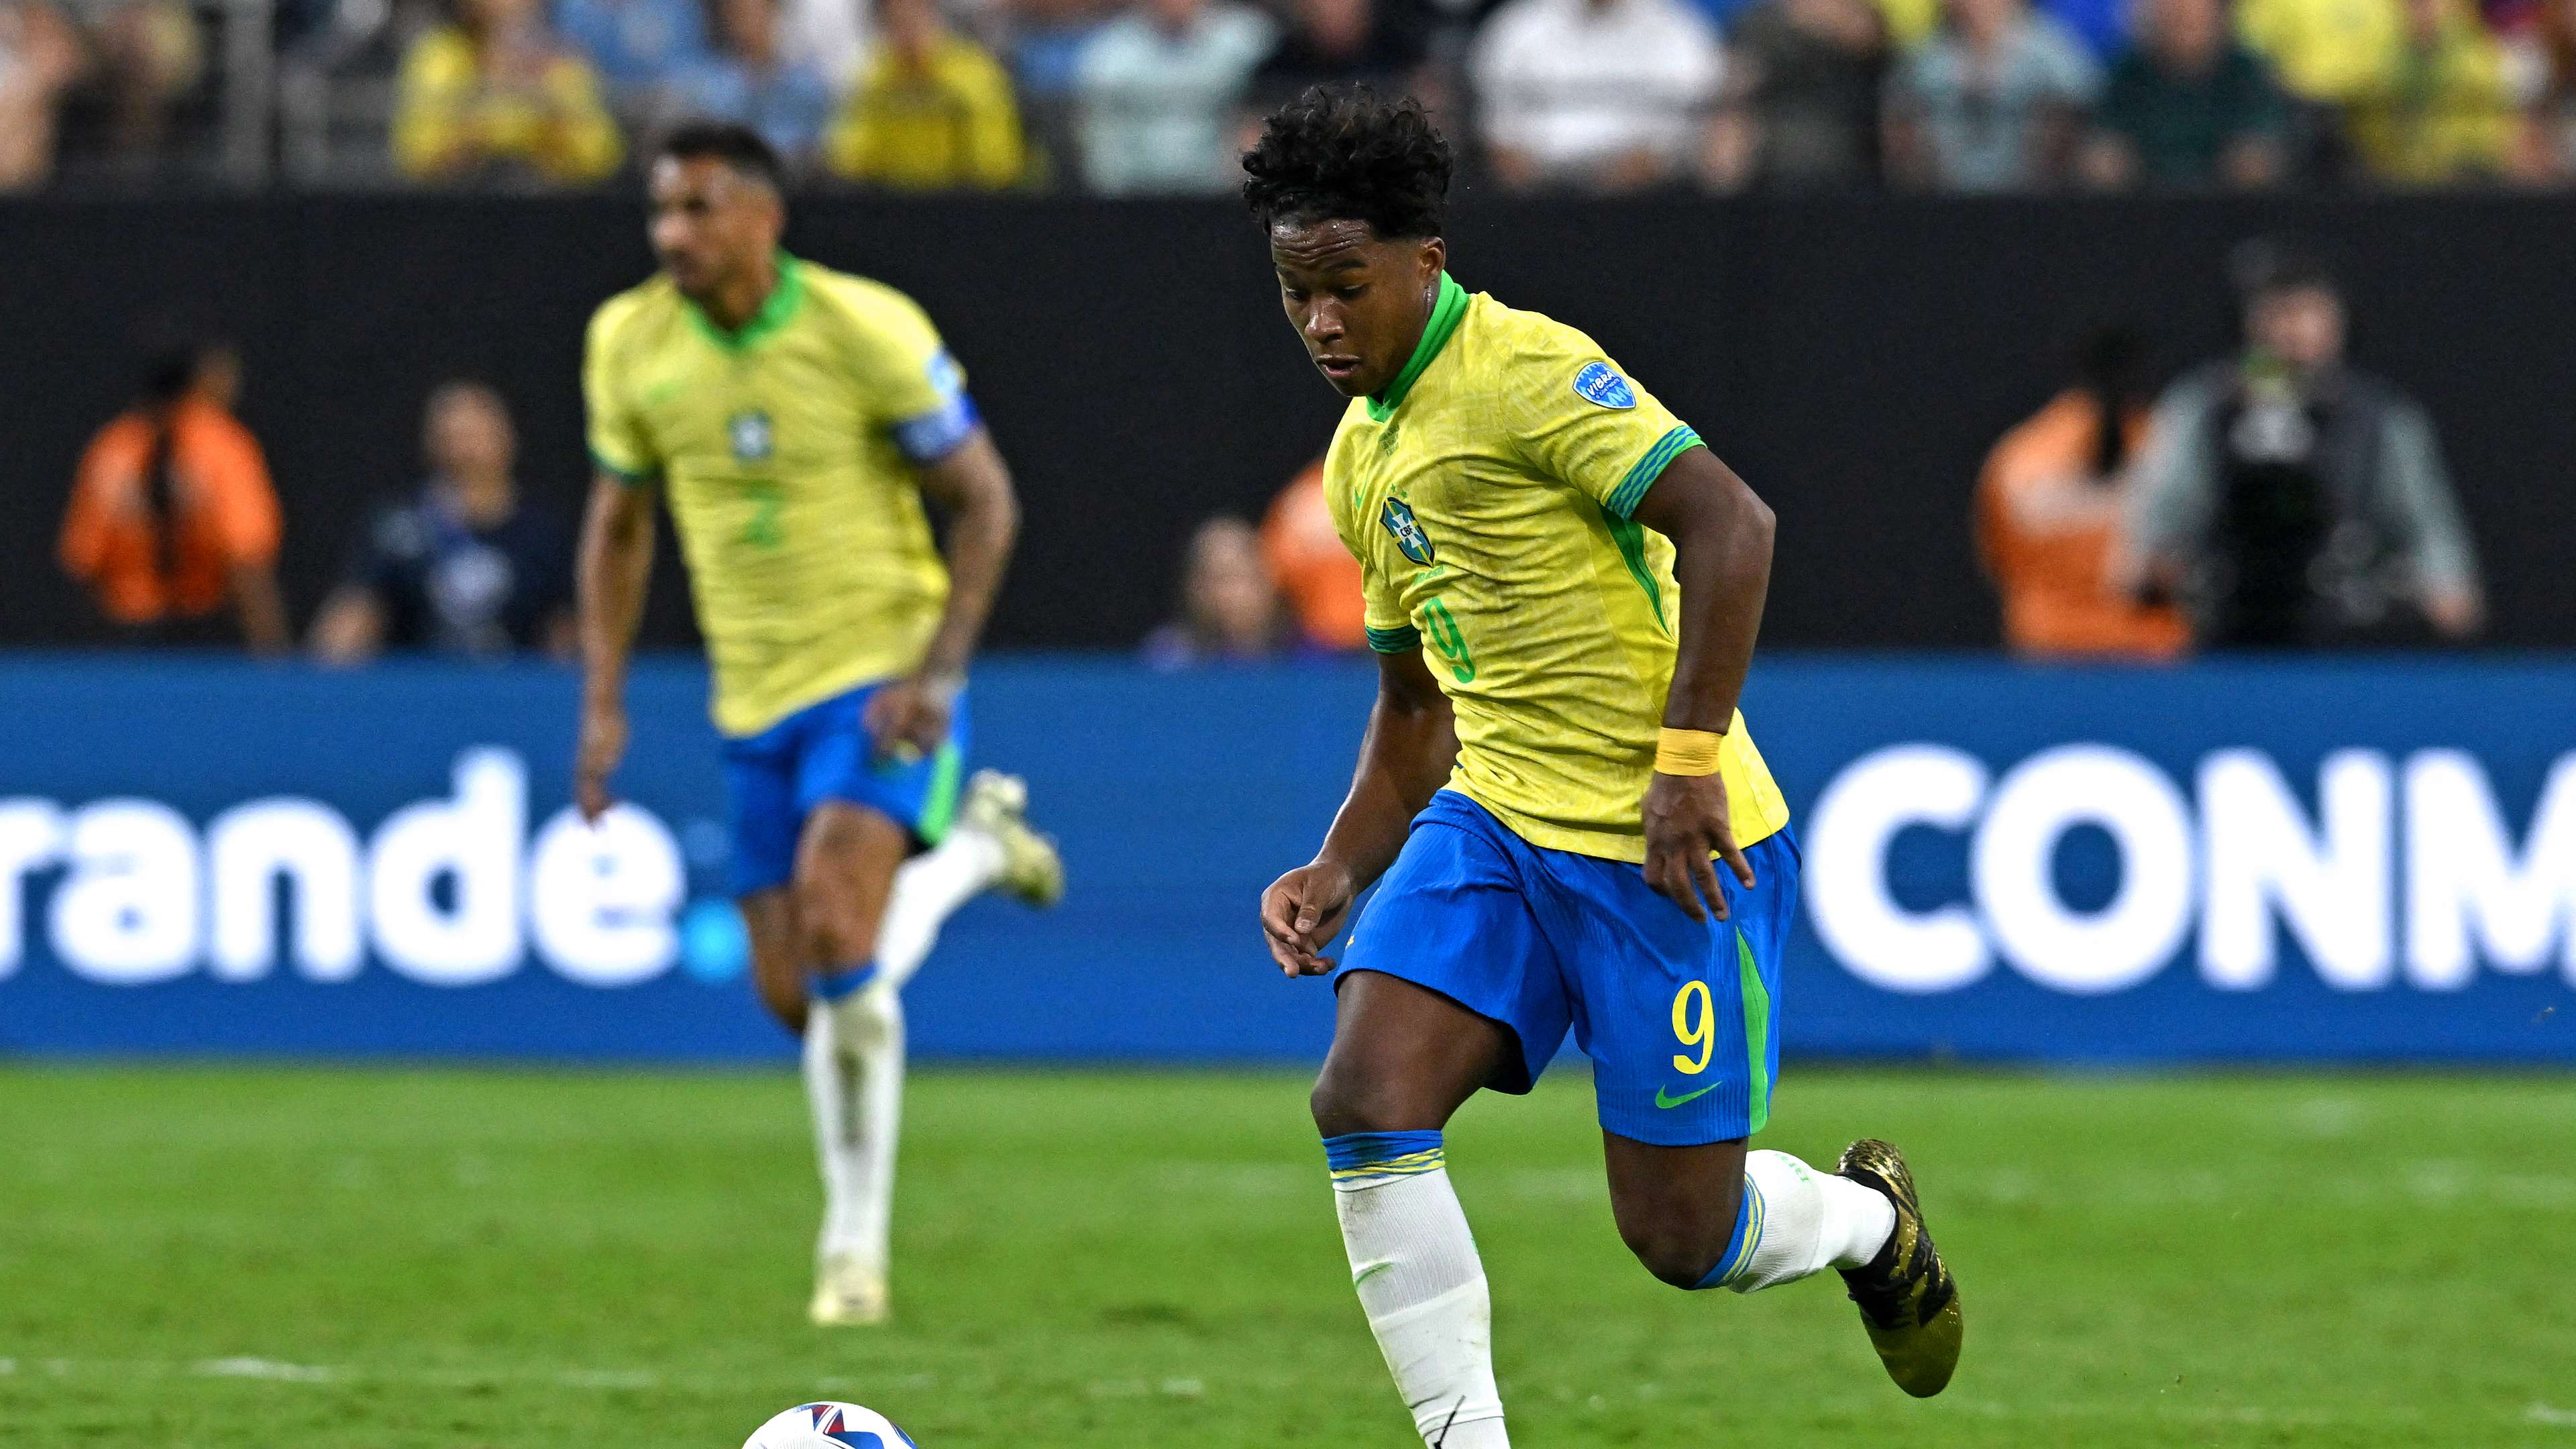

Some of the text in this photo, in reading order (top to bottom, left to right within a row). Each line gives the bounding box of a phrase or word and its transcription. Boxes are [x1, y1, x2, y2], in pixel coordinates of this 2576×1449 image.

[1587, 370, 1615, 395] VIBRA
[1400, 525, 1413, 537] CBF
[1424, 597, 1475, 684] 9
[1805, 744, 2576, 992] CONM
[1672, 980, 1715, 1075] 9
